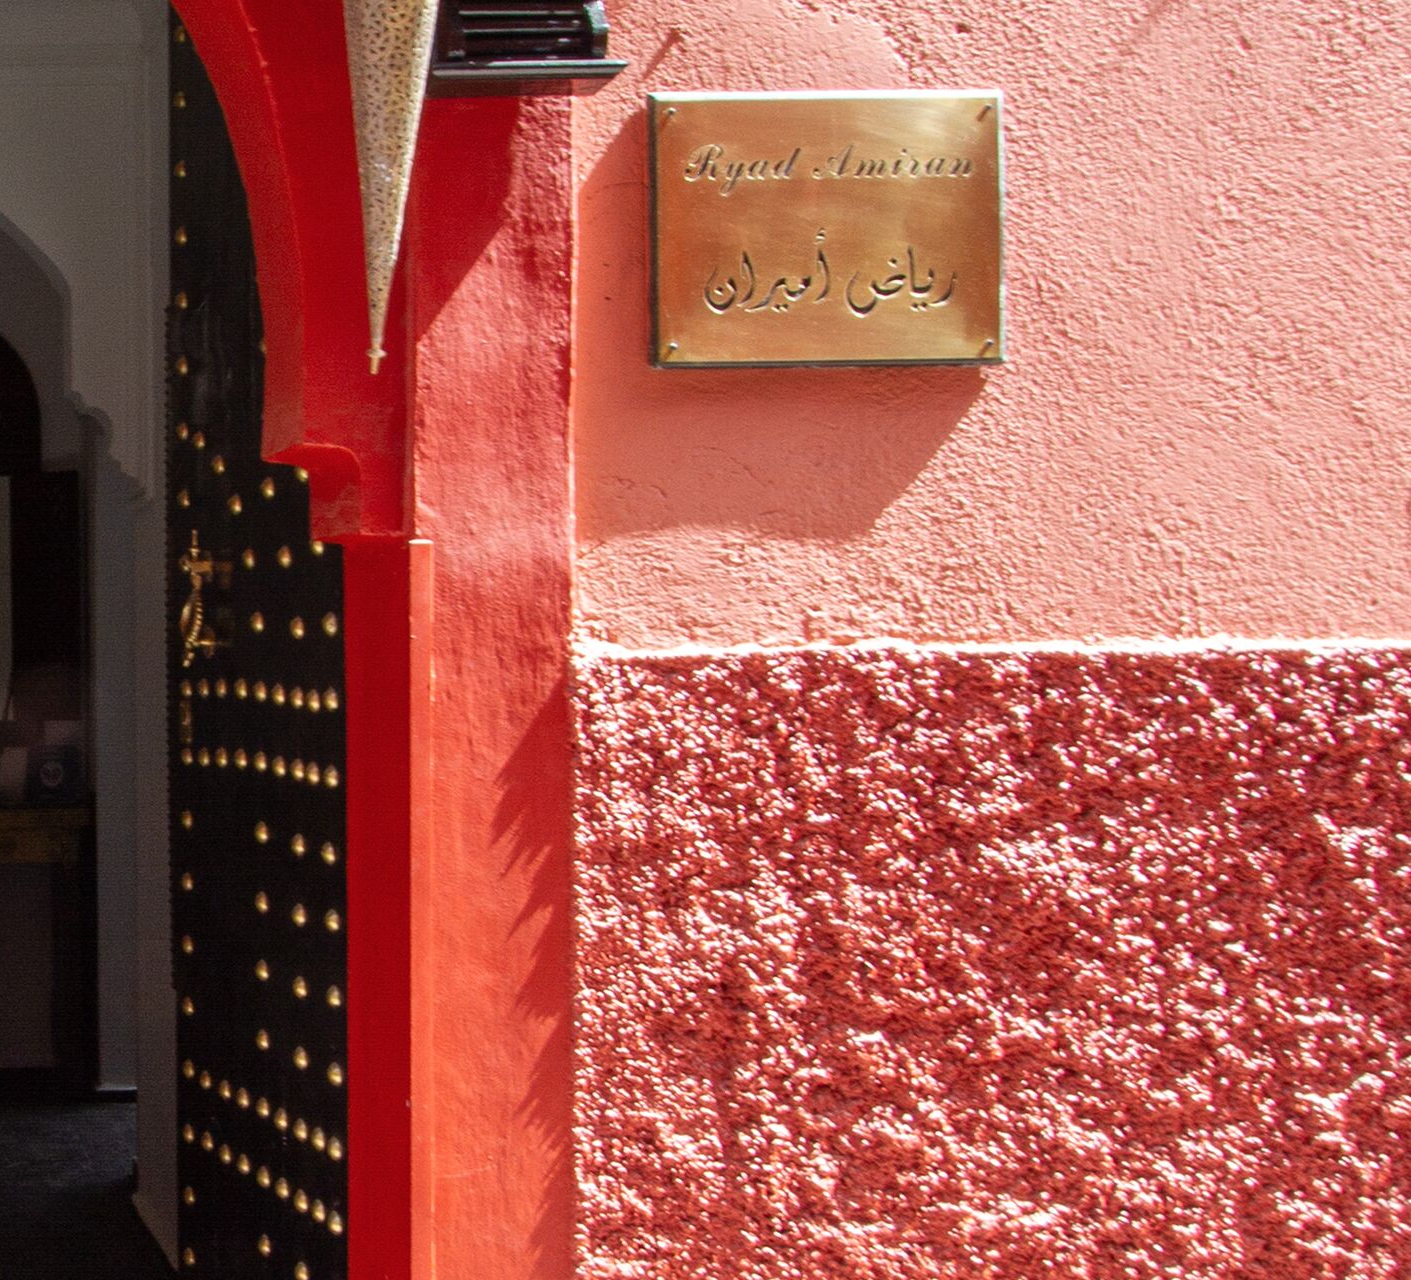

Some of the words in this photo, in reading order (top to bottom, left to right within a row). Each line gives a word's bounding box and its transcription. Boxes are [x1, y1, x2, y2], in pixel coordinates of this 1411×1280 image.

[684, 144, 802, 197] Ryad
[811, 143, 975, 180] Amiran
[703, 227, 831, 315] أميران
[846, 245, 958, 318] رياض
